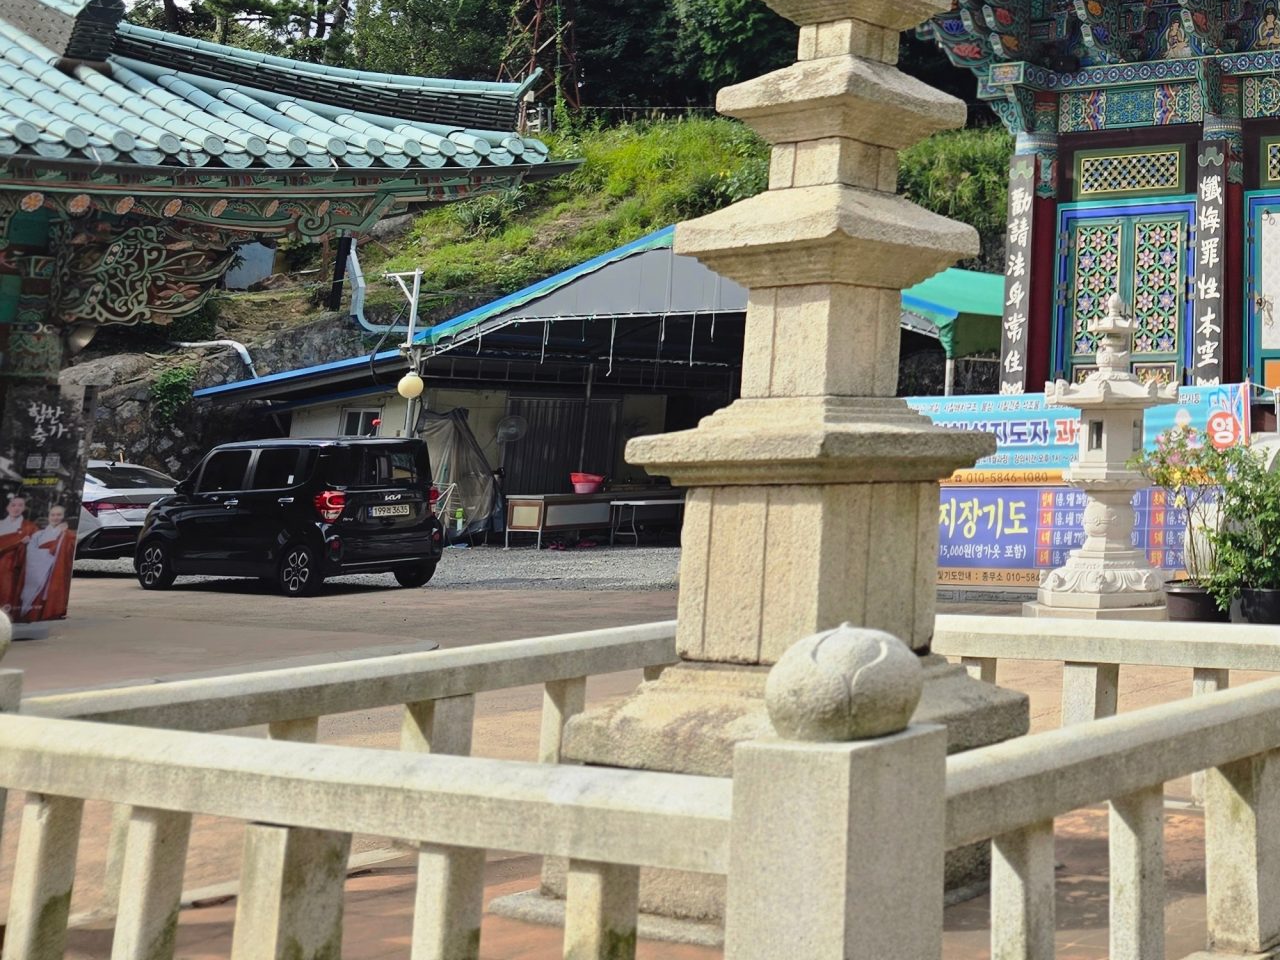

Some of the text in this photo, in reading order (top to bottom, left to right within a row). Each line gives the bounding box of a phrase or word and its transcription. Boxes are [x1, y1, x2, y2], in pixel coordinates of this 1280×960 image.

[1211, 416, 1235, 443] 영
[967, 472, 1048, 483] 010-5846-1080
[939, 498, 1028, 539] 지장기도
